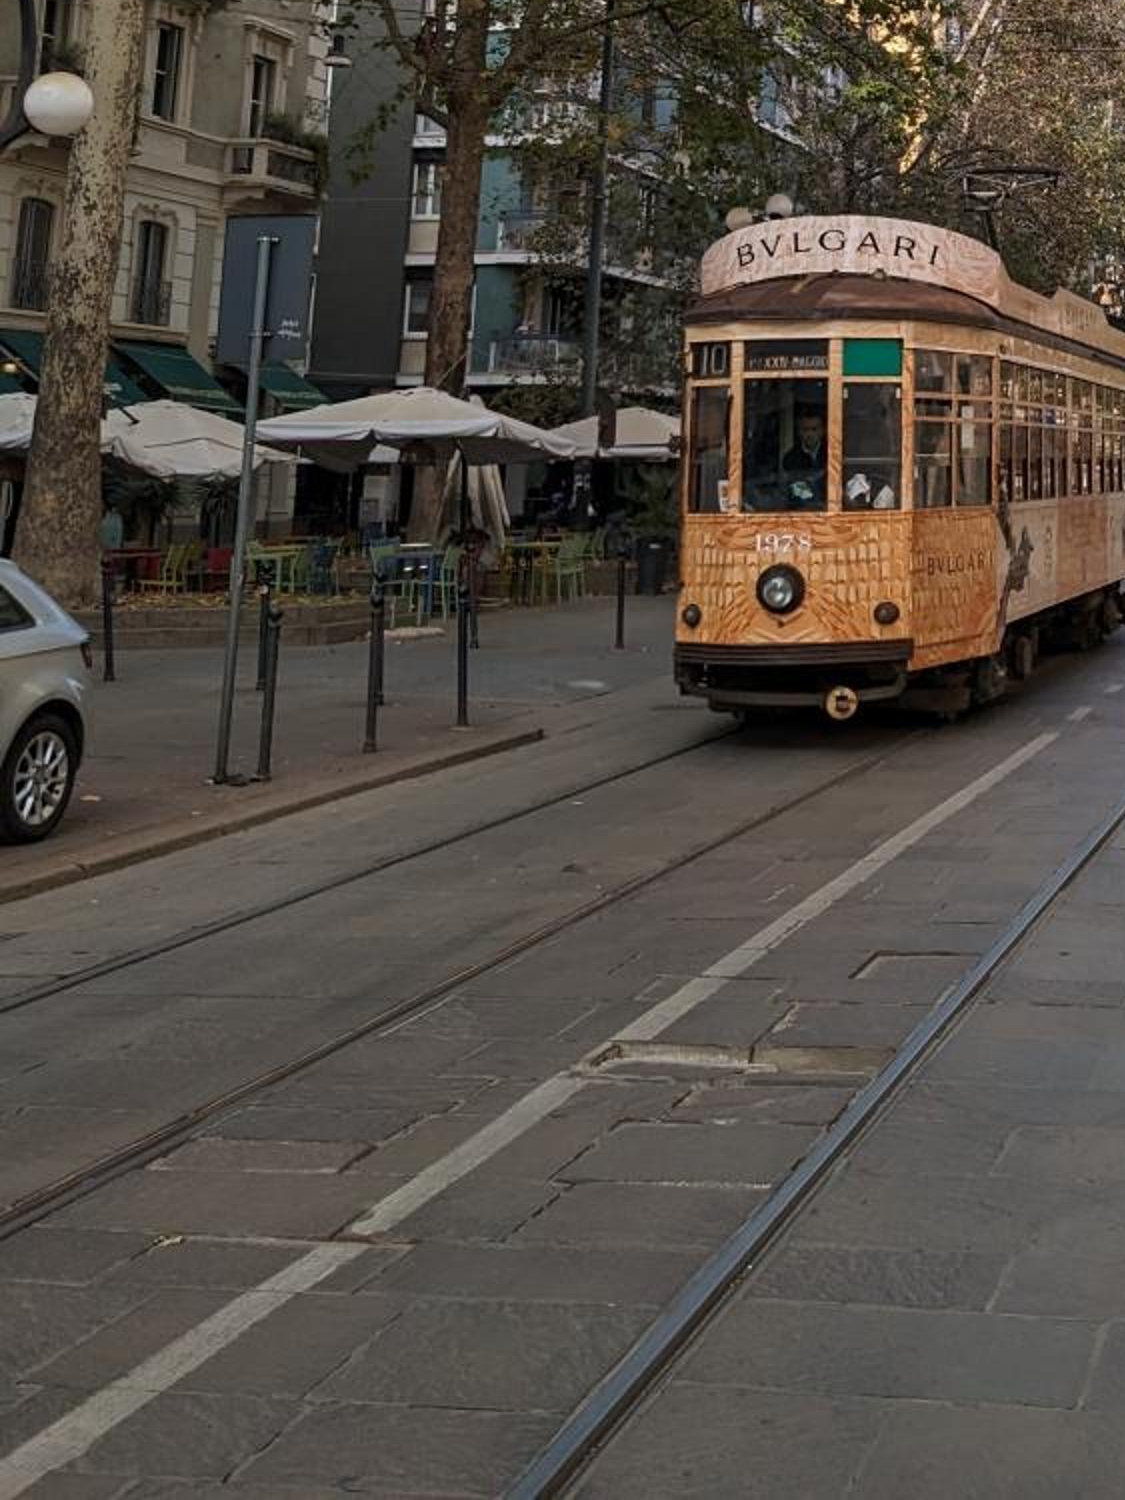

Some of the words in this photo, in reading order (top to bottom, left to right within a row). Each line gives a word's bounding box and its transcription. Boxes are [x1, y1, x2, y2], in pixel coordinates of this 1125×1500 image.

[736, 229, 939, 267] BVLGARI
[701, 344, 728, 377] 10
[926, 549, 993, 577] BVLGARI
